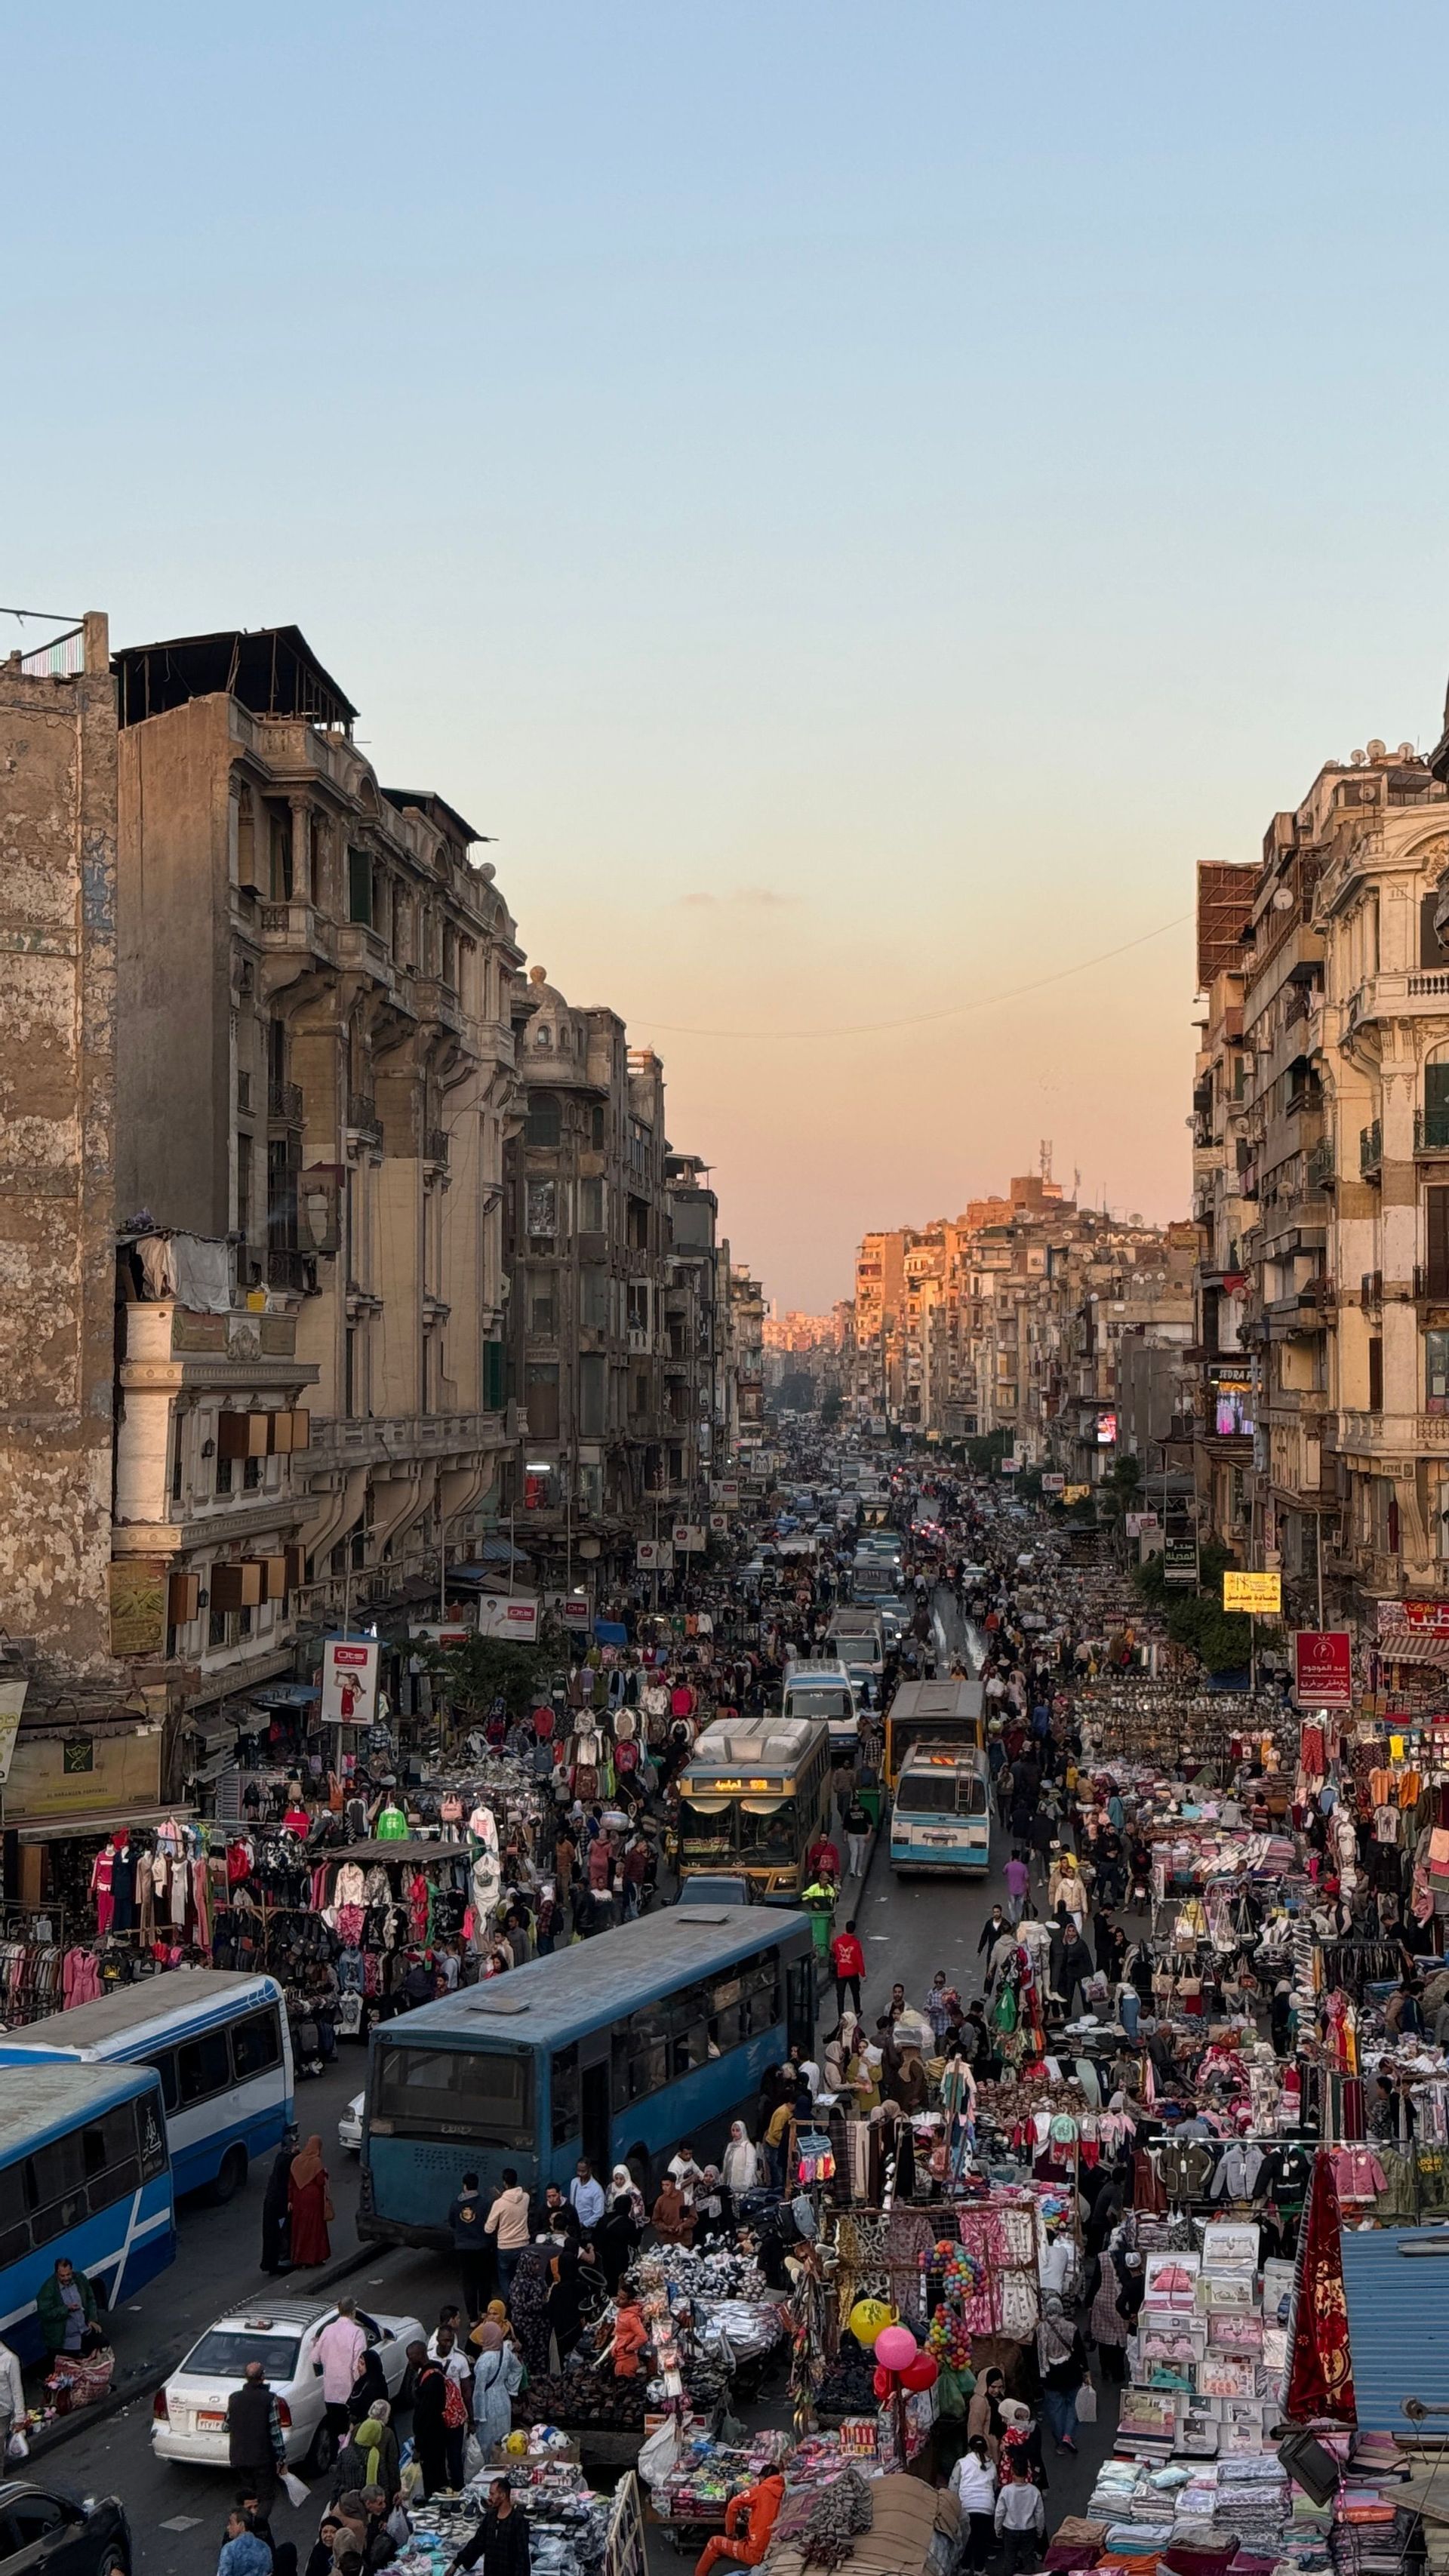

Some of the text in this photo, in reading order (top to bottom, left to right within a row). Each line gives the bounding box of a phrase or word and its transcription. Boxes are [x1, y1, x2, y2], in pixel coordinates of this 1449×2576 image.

[1219, 1370, 1244, 1380] SEDRA
[1165, 1552, 1195, 1562] المدينة
[1301, 1664, 1332, 1673] الموجود
